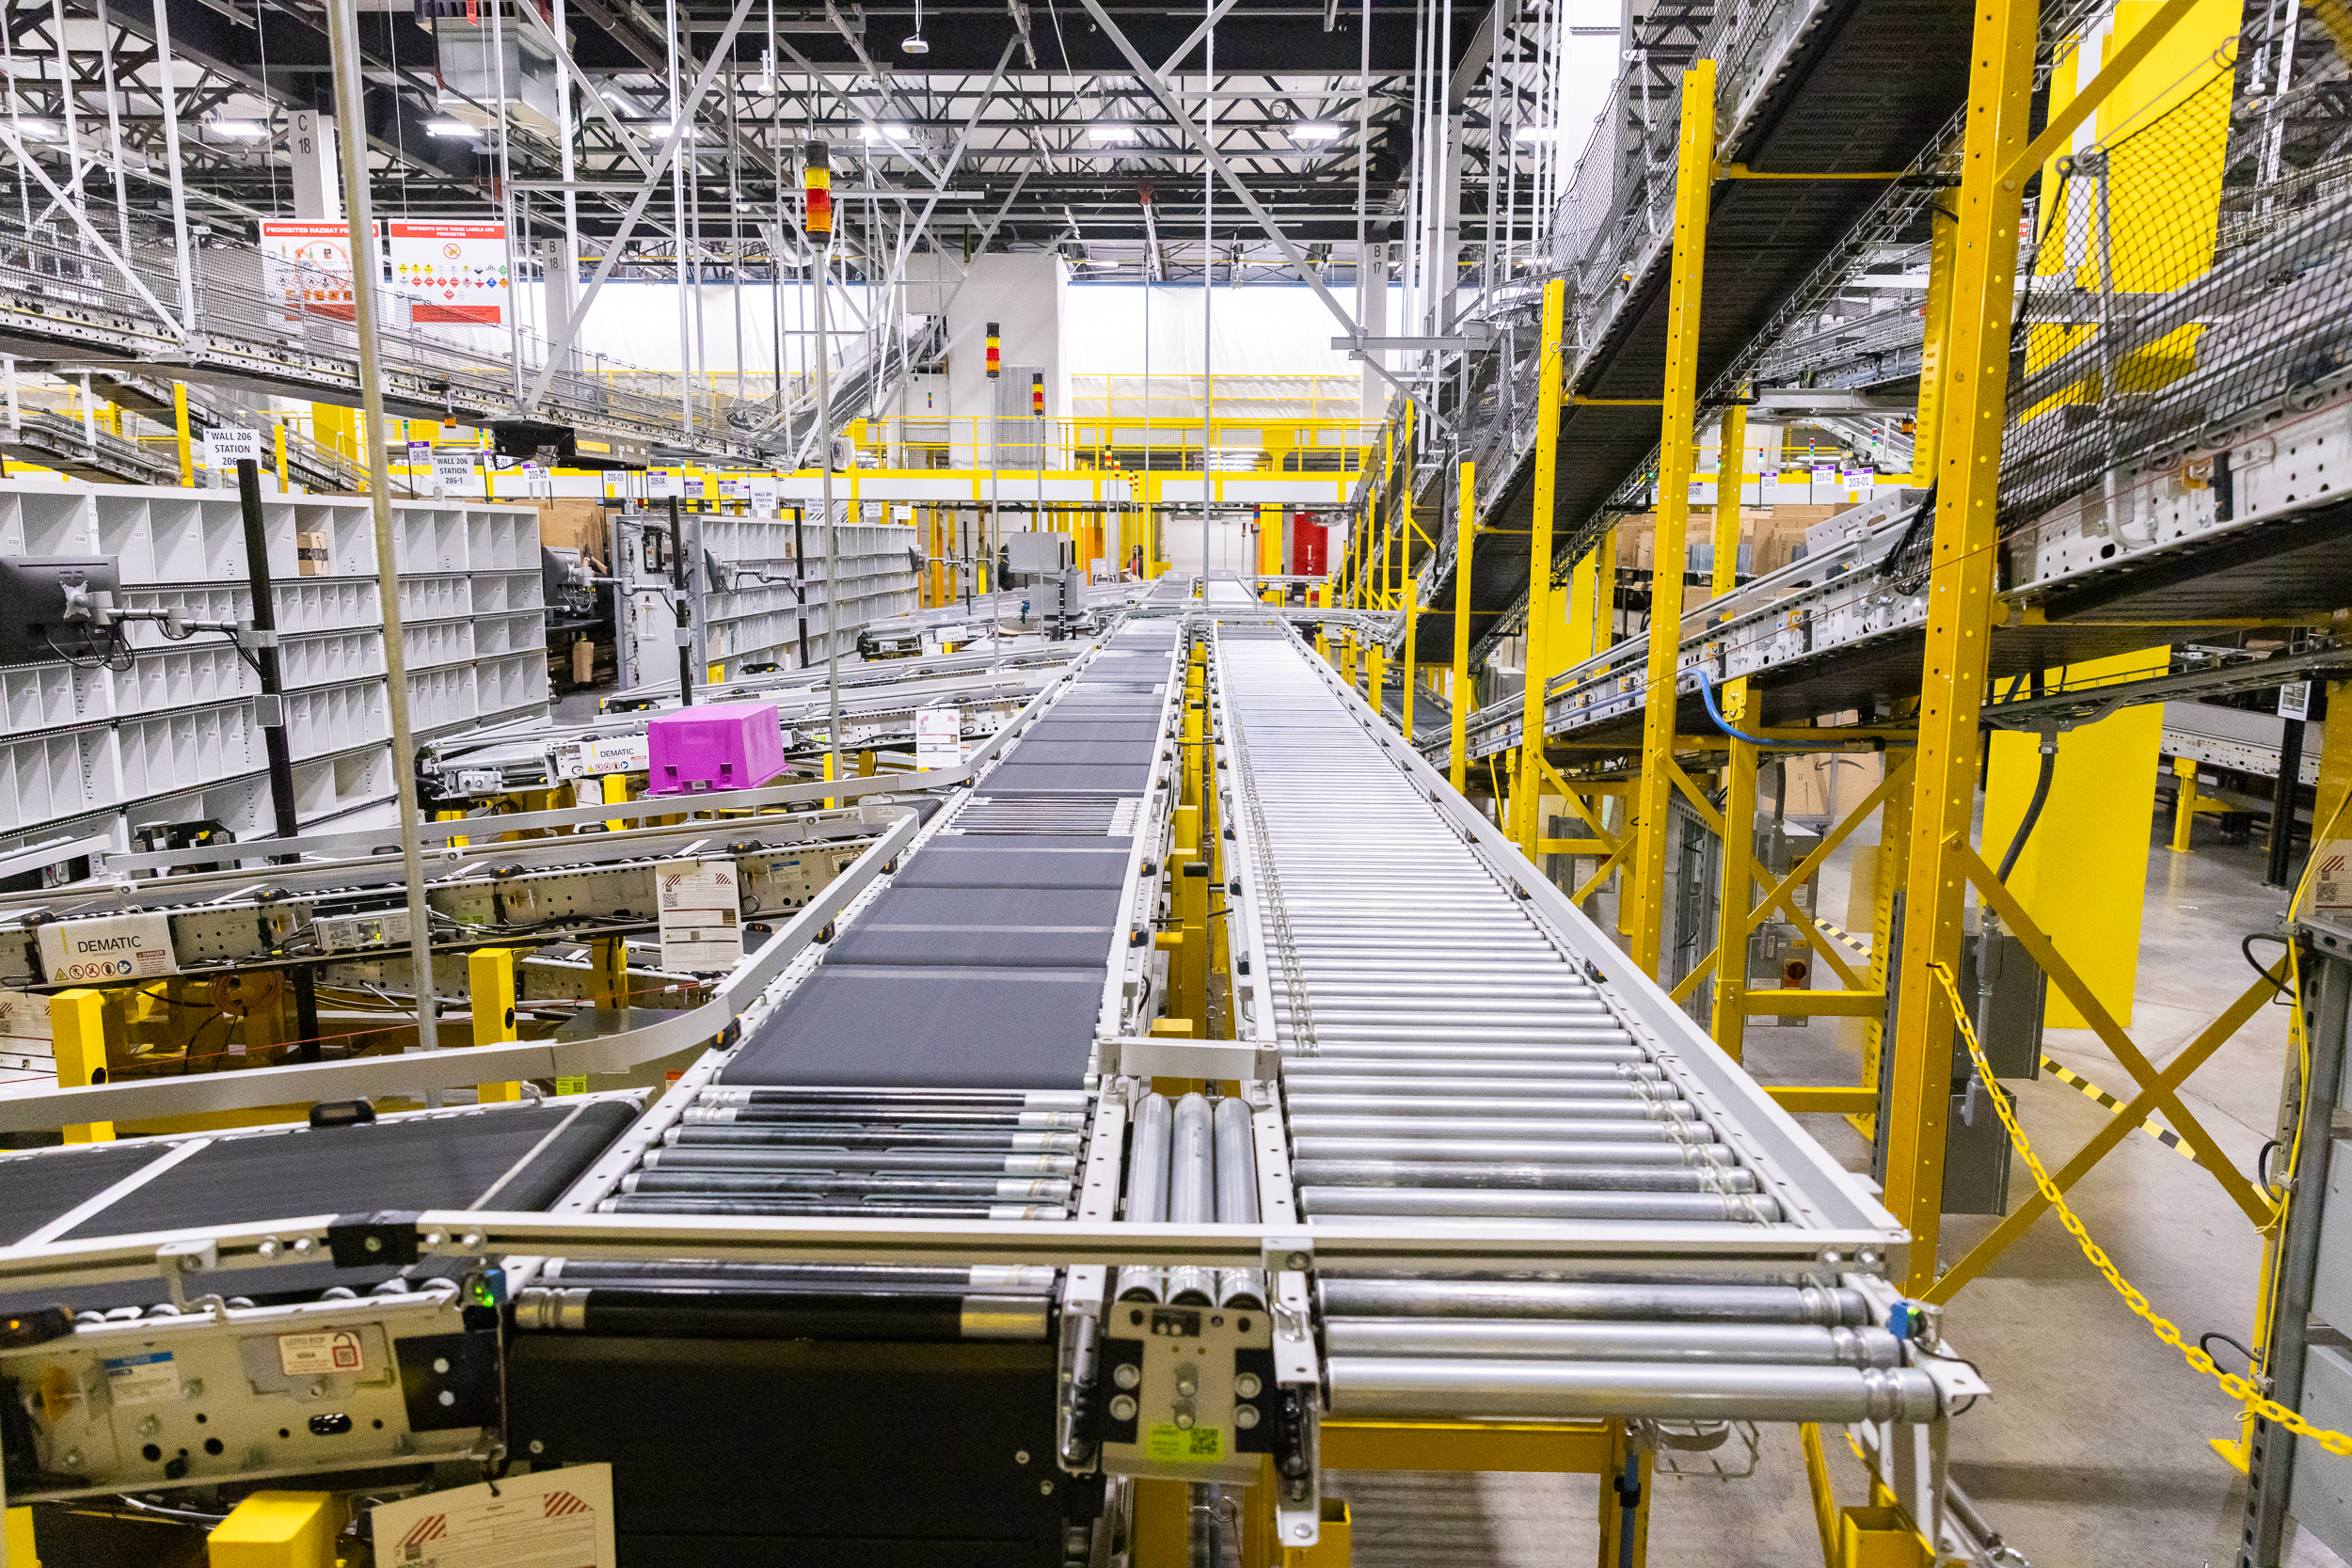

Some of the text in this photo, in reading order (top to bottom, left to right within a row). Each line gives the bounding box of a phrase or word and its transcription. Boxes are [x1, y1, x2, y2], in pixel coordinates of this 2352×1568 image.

[298, 114, 307, 131] C
[298, 137, 311, 154] 18
[549, 241, 556, 253] B
[1374, 245, 1381, 257] B
[549, 257, 558, 269] 18
[1373, 262, 1382, 274] 17
[237, 432, 252, 441] 206
[215, 445, 250, 453] STATION
[490, 458, 507, 467] 25-01
[1816, 473, 1831, 481] 203-02
[1849, 477, 1869, 487] 203-01
[600, 748, 634, 758] DEMATIC
[77, 936, 141, 953] DEMATIC
